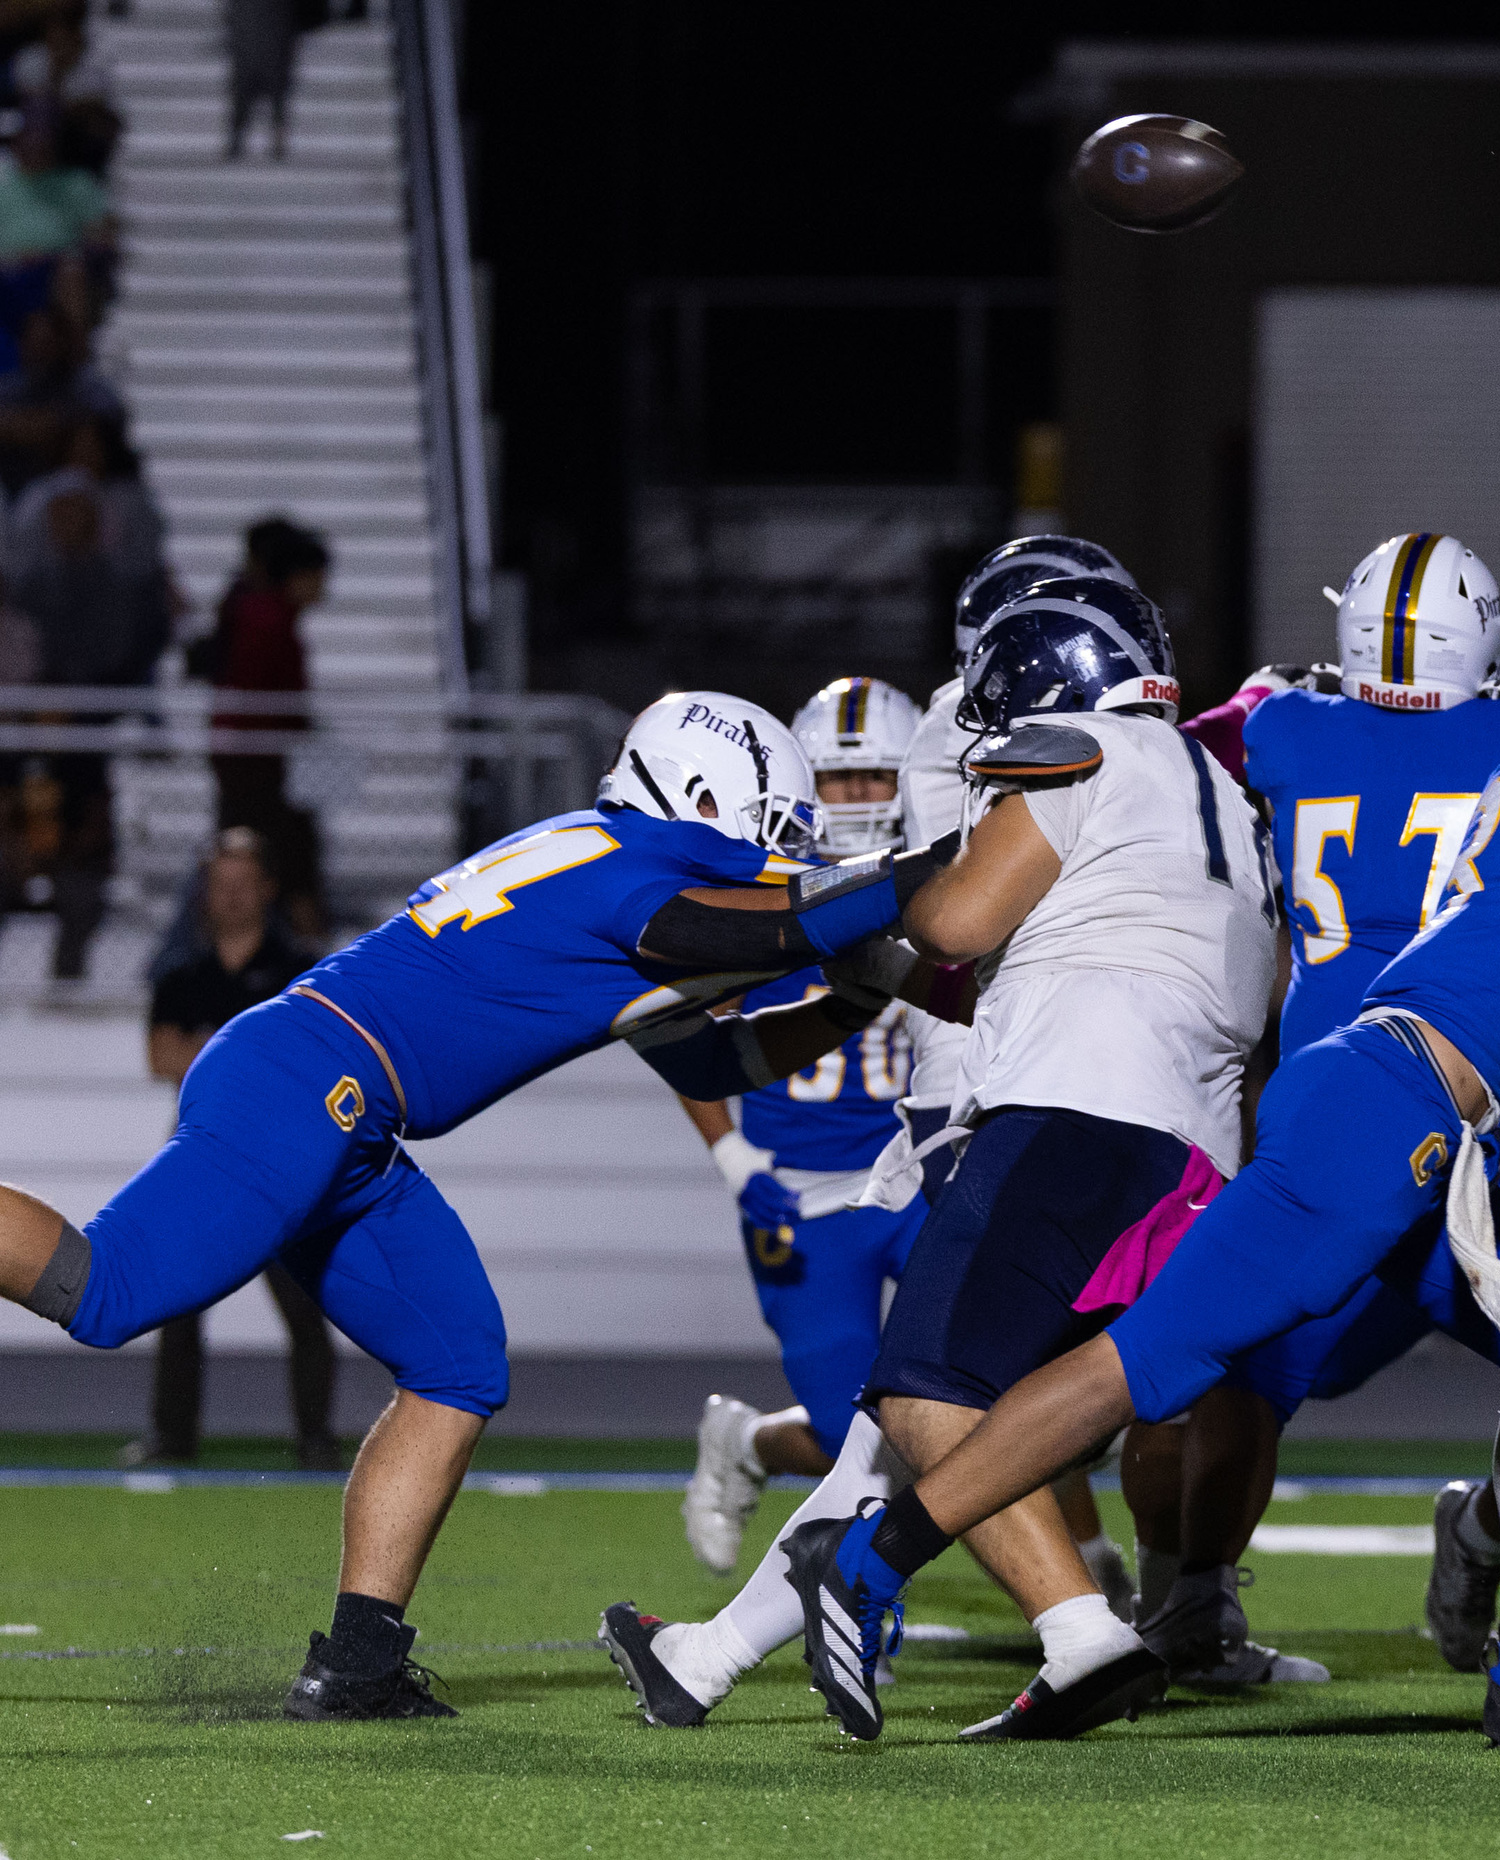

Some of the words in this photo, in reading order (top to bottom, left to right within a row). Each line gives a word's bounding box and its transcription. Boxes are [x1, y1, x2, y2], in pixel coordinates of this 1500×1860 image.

[1359, 682, 1441, 709] Riddell
[1293, 793, 1484, 966] 57
[325, 1075, 364, 1132] C
[1409, 1131, 1448, 1187] C
